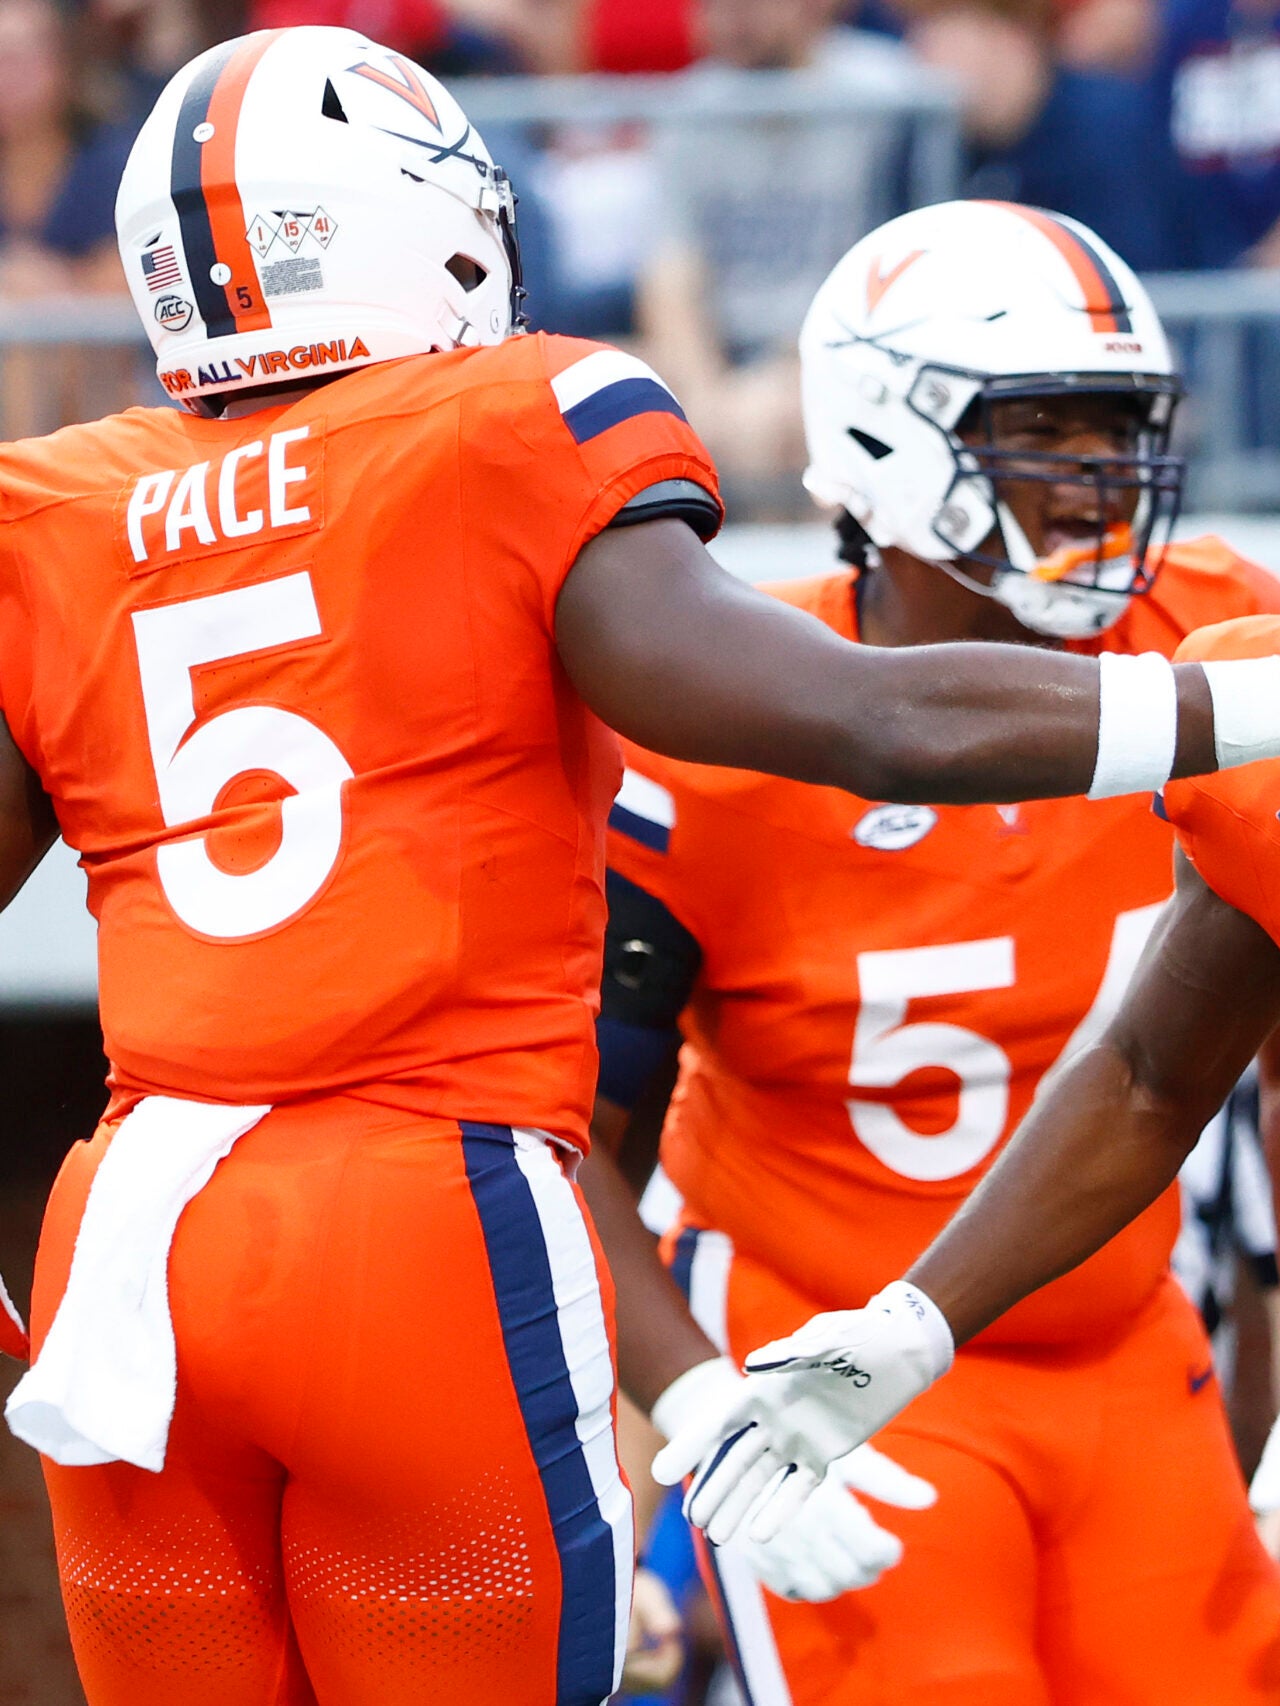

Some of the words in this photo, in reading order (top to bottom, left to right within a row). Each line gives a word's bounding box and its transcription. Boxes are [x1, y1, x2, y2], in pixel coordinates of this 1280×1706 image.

[284, 221, 300, 237] 15
[314, 217, 329, 233] 41
[236, 286, 252, 308] 5
[160, 300, 185, 320] ACC
[234, 336, 371, 377] VIRGINIA
[126, 426, 312, 562] PACE
[131, 570, 355, 938] 5
